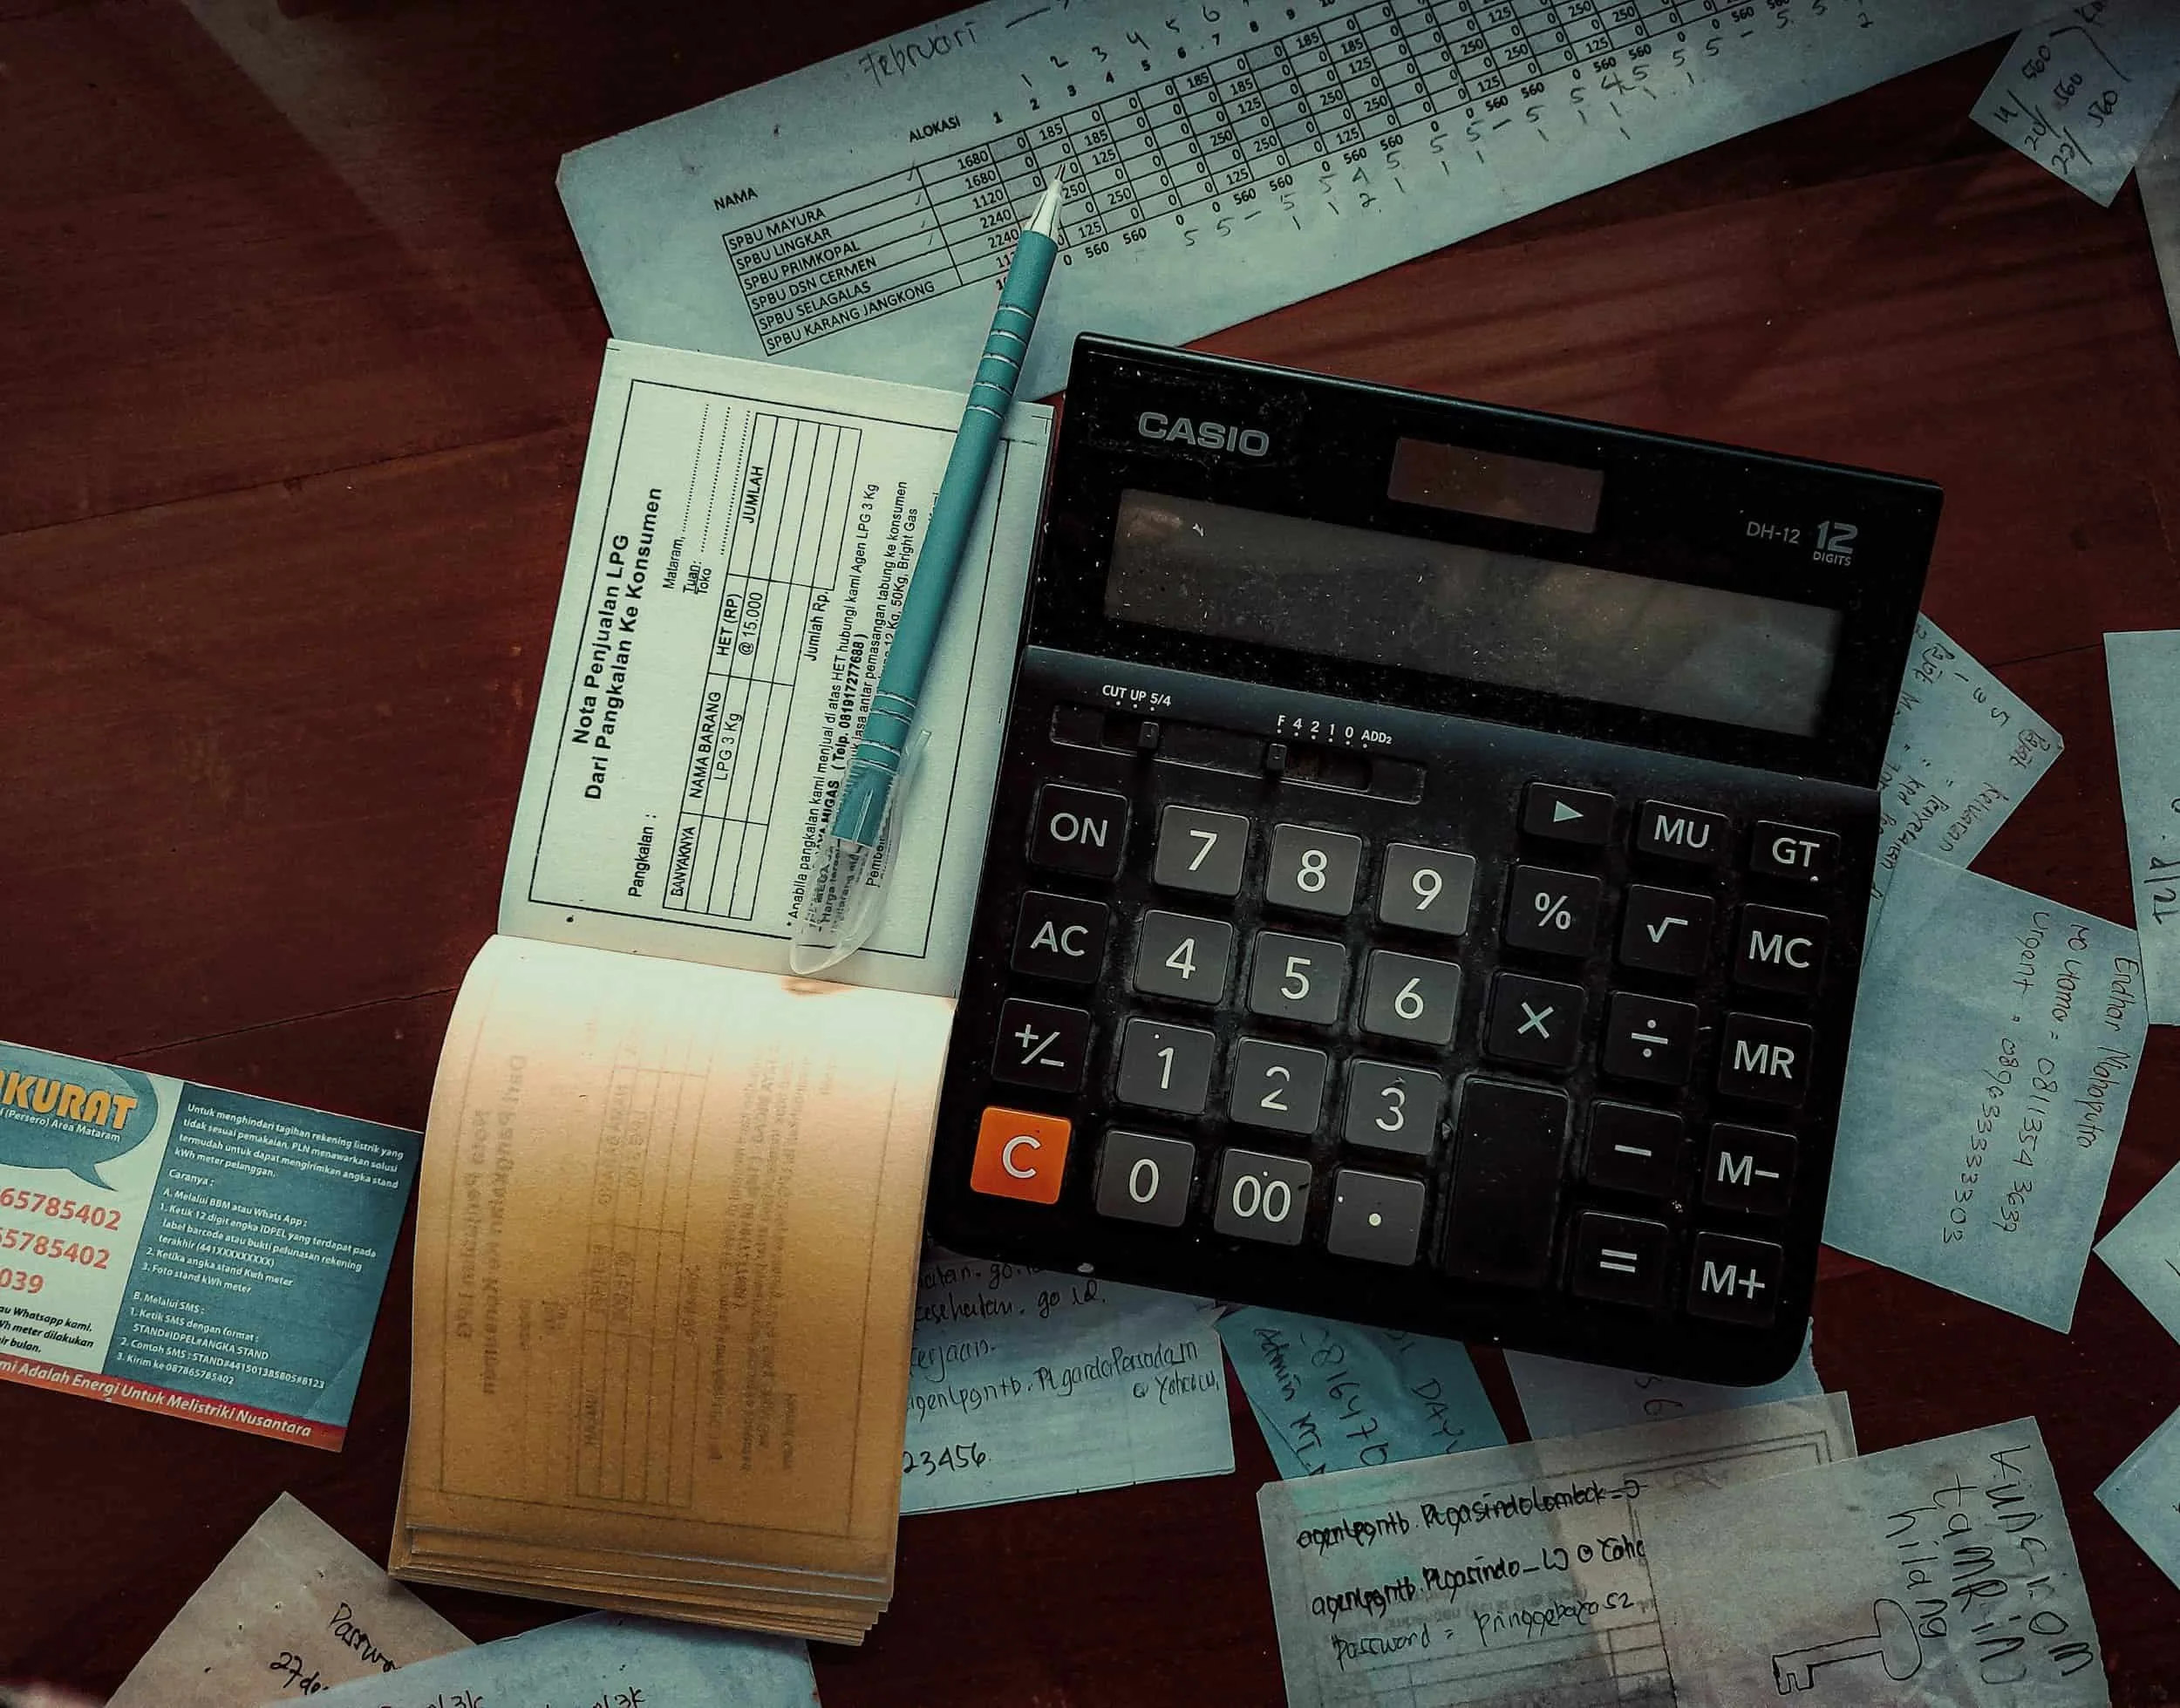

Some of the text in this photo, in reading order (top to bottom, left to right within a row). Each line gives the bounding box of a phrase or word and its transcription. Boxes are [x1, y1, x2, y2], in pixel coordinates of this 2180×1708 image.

[909, 115, 960, 142] ALOKASI
[957, 150, 988, 170] 1680
[1343, 146, 1368, 164] 560
[712, 187, 758, 210] NAMA
[964, 169, 996, 189] 1680
[971, 188, 1004, 209] 1120
[728, 207, 826, 250] SPBU MAYURA
[979, 208, 1012, 228] 2240
[1122, 227, 1147, 244] 560
[732, 227, 832, 269] SPBU LINGKAR
[987, 228, 1021, 248] 2240
[1084, 241, 1108, 258] 560
[743, 240, 861, 289] SPBU PRIMKOPAL
[747, 255, 876, 310] SPBU DSN CERMEN
[758, 280, 871, 330] SPBU SELAGALAS
[763, 281, 935, 350] SPBU KARANG JANGKONG
[1137, 411, 1269, 456] CASIO
[741, 465, 764, 523] JUMLAH
[862, 484, 879, 500] Kg
[886, 481, 907, 541] konsumen
[855, 513, 870, 539] LPG
[903, 508, 917, 531] Gas
[1746, 521, 1800, 544] DH-12
[1816, 520, 1857, 555] 12
[850, 542, 866, 573] Agen
[882, 543, 896, 557] ke
[896, 534, 914, 569] Bright
[1812, 550, 1850, 566] DIGITS
[696, 568, 712, 595] Toko
[843, 574, 861, 602] kami
[875, 561, 896, 600] tabung
[571, 534, 628, 744] Nota Penjualan LPG
[715, 593, 742, 656] HET (RP)
[738, 591, 763, 655] @ 15.000
[803, 591, 830, 661] Jumlah Rp.
[835, 605, 857, 652] hubungi
[864, 603, 886, 679] pemasangan
[583, 487, 662, 799] Dari Pangkalan Ke Konsumen
[831, 654, 846, 681] HET
[838, 641, 864, 728] 081917277688
[828, 684, 841, 710] atas
[859, 681, 872, 712] antar
[1101, 684, 1170, 705] CUT UP 5/4
[824, 711, 835, 723] di
[1277, 714, 1353, 742] F 4 2 1 0
[688, 691, 721, 798] NAMA BARANG
[713, 712, 742, 780] LPG 3 Kg
[816, 726, 834, 772] menjual
[807, 776, 825, 804] kami
[799, 807, 819, 870] pangkalan
[1050, 812, 1107, 847] ON
[1653, 814, 1709, 847] MU
[627, 826, 654, 897] Pangkalan
[670, 827, 695, 896] BANYAKNYA
[1189, 829, 1216, 870] 7
[1772, 836, 1820, 867] GT
[1297, 849, 1326, 891] 8
[1412, 868, 1441, 909] 9
[1535, 892, 1570, 929] %
[1030, 921, 1087, 956] AC
[1165, 937, 1196, 978] 4
[1748, 929, 1812, 968] MC
[1281, 956, 1310, 999] 5
[1394, 977, 1423, 1019] 6
[1158, 1047, 1174, 1088] 1
[1734, 1039, 1795, 1079] MR
[0, 1071, 137, 1131] KURAT
[1260, 1066, 1290, 1110] 2
[1375, 1087, 1405, 1131] 3
[50, 1119, 77, 1132] Area
[75, 1122, 122, 1142] Mataram
[184, 1102, 404, 1160] Untuk menghindari tagihan rekening listrik yang
[174, 1146, 197, 1159] kWh
[196, 1150, 224, 1165] meter
[179, 1133, 399, 1188] termudah untuk dapat mengirimkan angka stand
[1002, 1135, 1039, 1178] C
[1129, 1158, 1159, 1202] 0
[1232, 1175, 1291, 1221] 00
[1700, 1260, 1765, 1298] M+
[11, 1324, 93, 1348] meter dilakukan
[12, 1306, 92, 1331] Whatsapp kami.
[10, 1337, 41, 1352] bulan.
[15, 1363, 311, 1437] Adalah Energi Untuk Melistriki Nusantara
[1885, 1507, 1948, 1638] hilang
